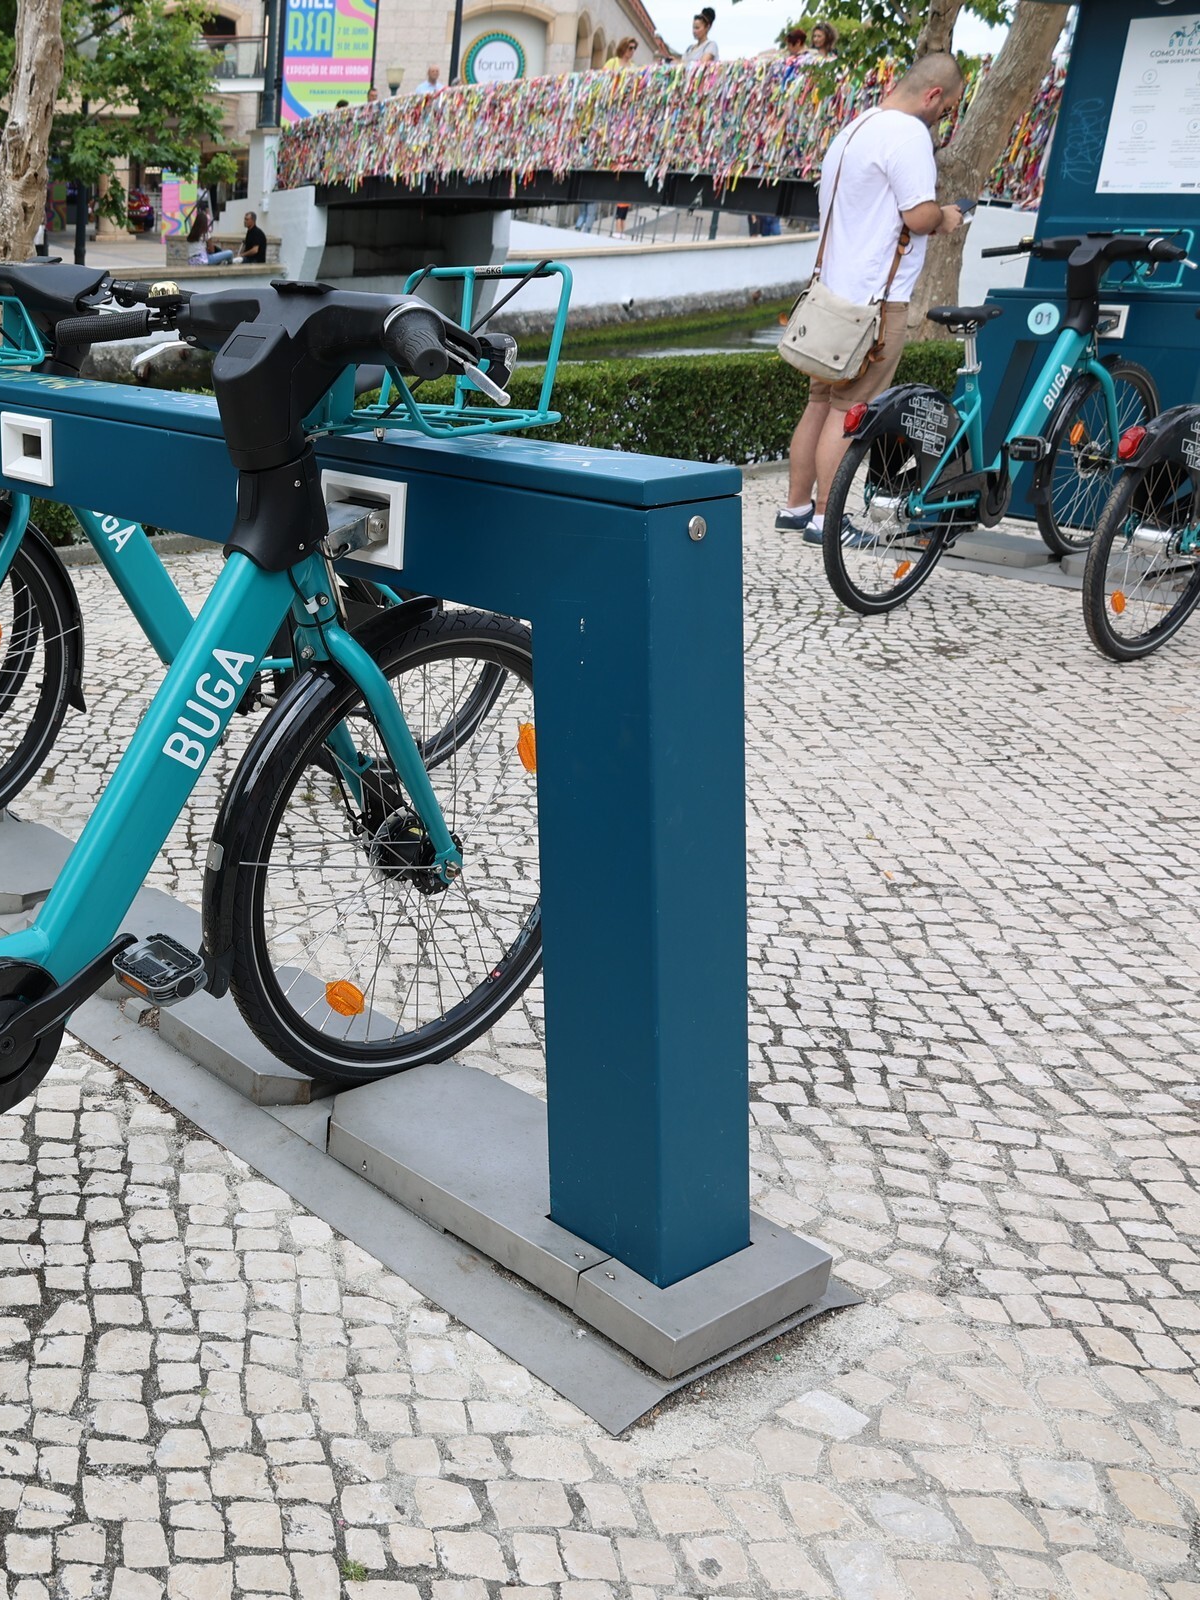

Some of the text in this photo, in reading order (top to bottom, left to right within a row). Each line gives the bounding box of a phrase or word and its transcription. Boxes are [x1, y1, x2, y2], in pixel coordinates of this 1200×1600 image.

[1150, 49, 1175, 58] COMO
[286, 64, 319, 76] EXPOSIÇÃO
[320, 65, 328, 75] DE
[478, 57, 515, 71] forum
[486, 266, 502, 275] 6KG
[1034, 311, 1052, 326] 01
[1043, 363, 1072, 411] BUGA
[163, 648, 255, 770] BUGA
